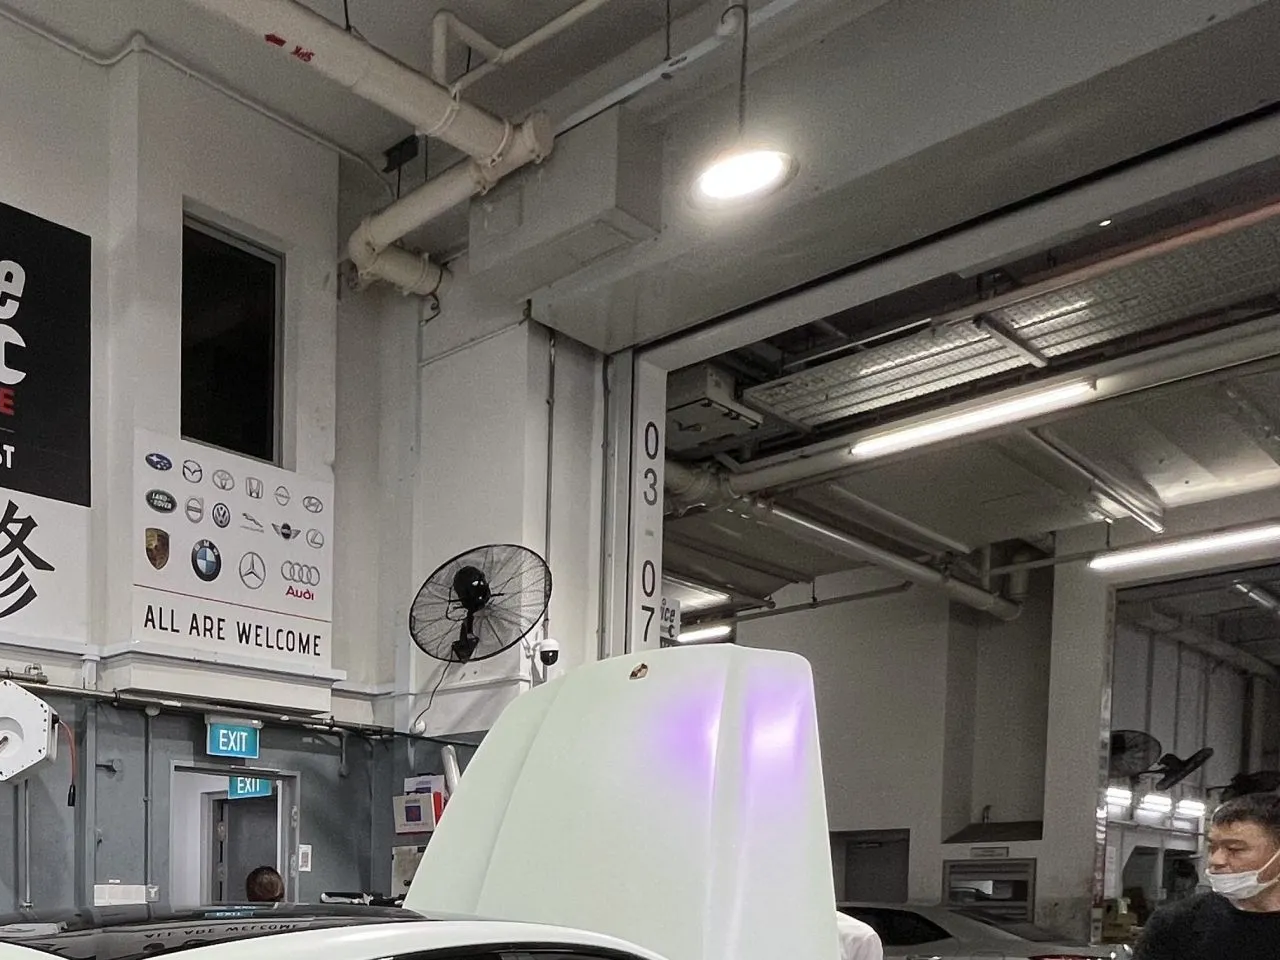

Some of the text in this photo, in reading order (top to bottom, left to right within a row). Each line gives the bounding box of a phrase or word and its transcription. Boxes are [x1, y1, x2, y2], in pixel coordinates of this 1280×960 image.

[285, 585, 314, 601] Audi
[144, 604, 321, 657] ALL ARE WELCOME
[219, 729, 249, 753] EXIT
[237, 777, 260, 794] EXIT
